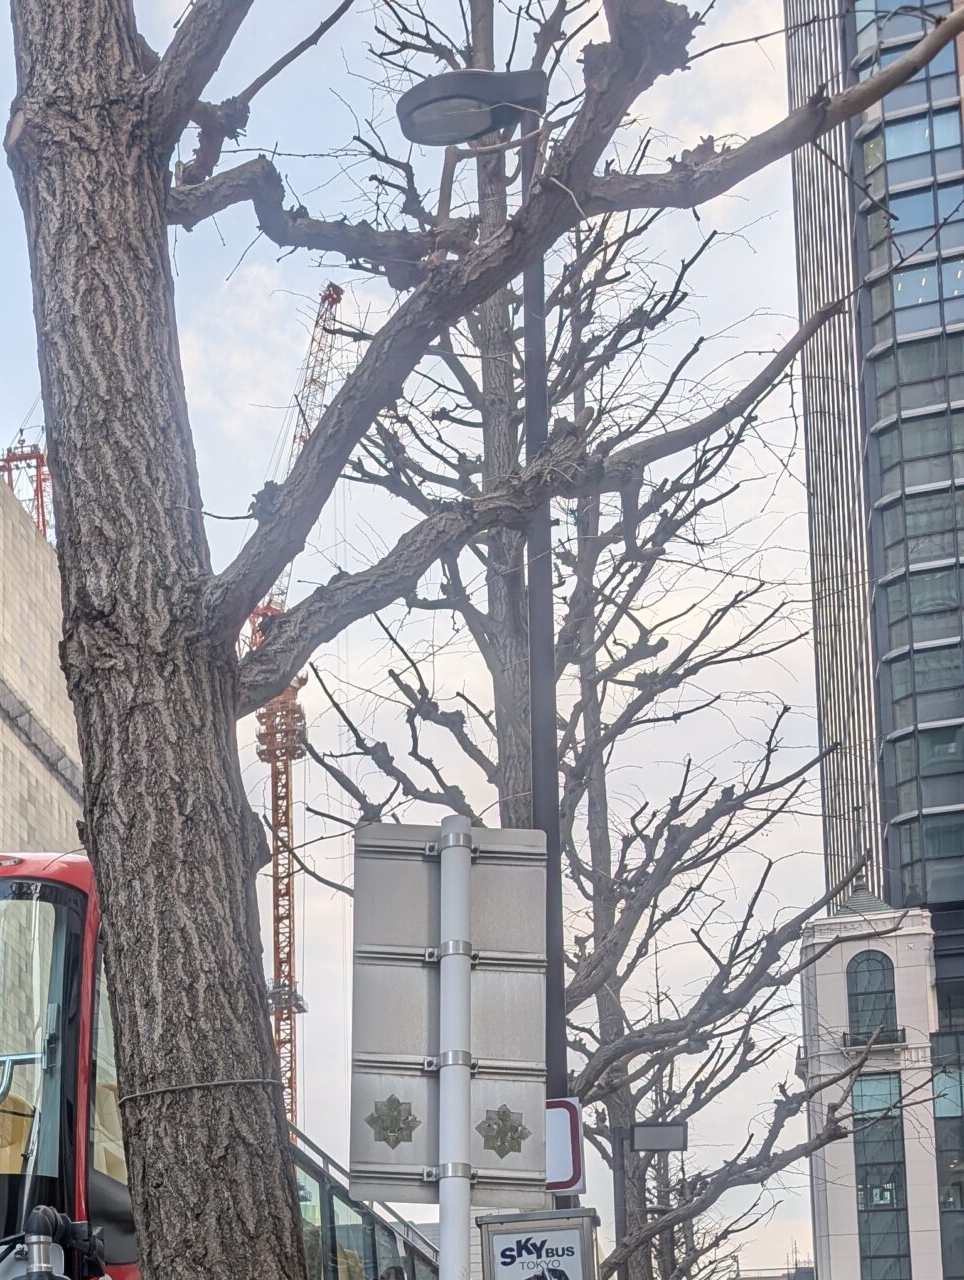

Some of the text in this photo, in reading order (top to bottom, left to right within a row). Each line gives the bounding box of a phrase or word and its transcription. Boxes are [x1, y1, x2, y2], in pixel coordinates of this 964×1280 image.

[500, 1237, 575, 1267] SKY BUS
[519, 1259, 561, 1271] TOKYO
